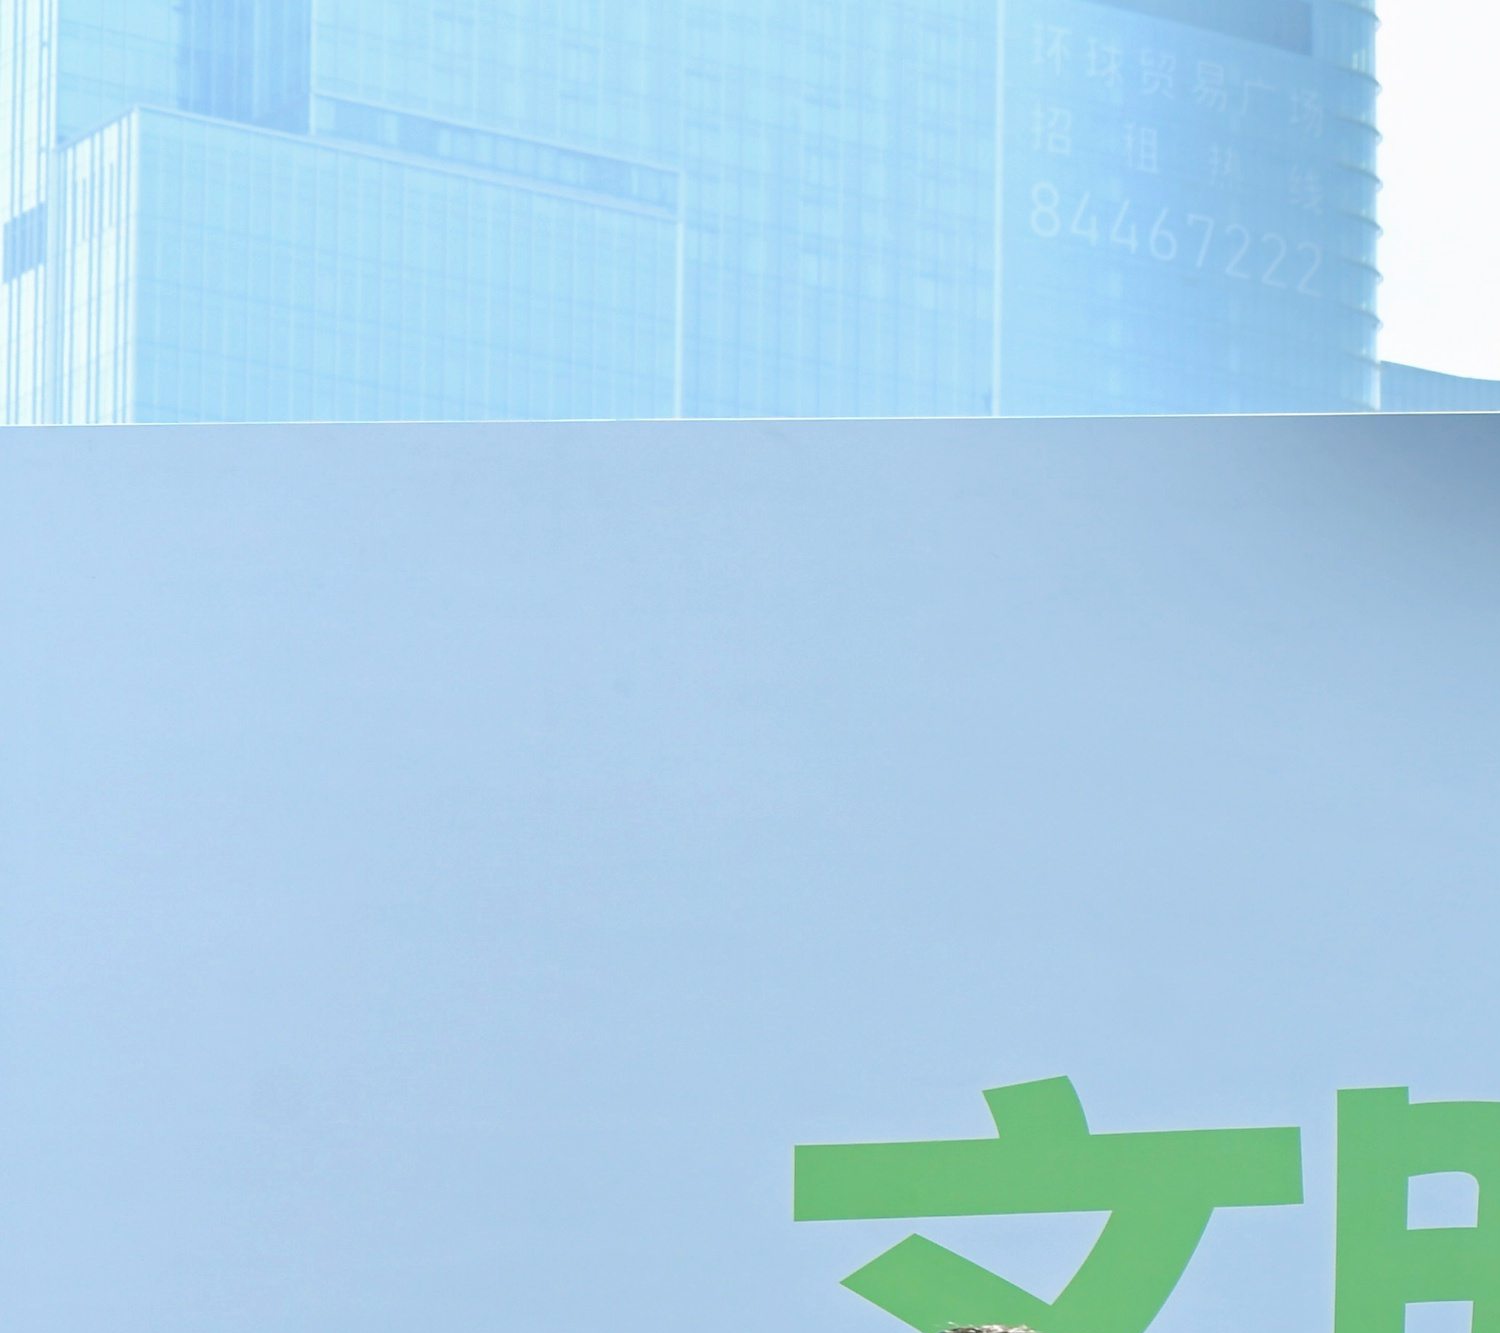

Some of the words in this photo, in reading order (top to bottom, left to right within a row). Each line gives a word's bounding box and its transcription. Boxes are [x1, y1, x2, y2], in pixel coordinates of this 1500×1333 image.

[1031, 23, 1325, 139] 环球贸易广场
[1030, 180, 1324, 298] 84467222
